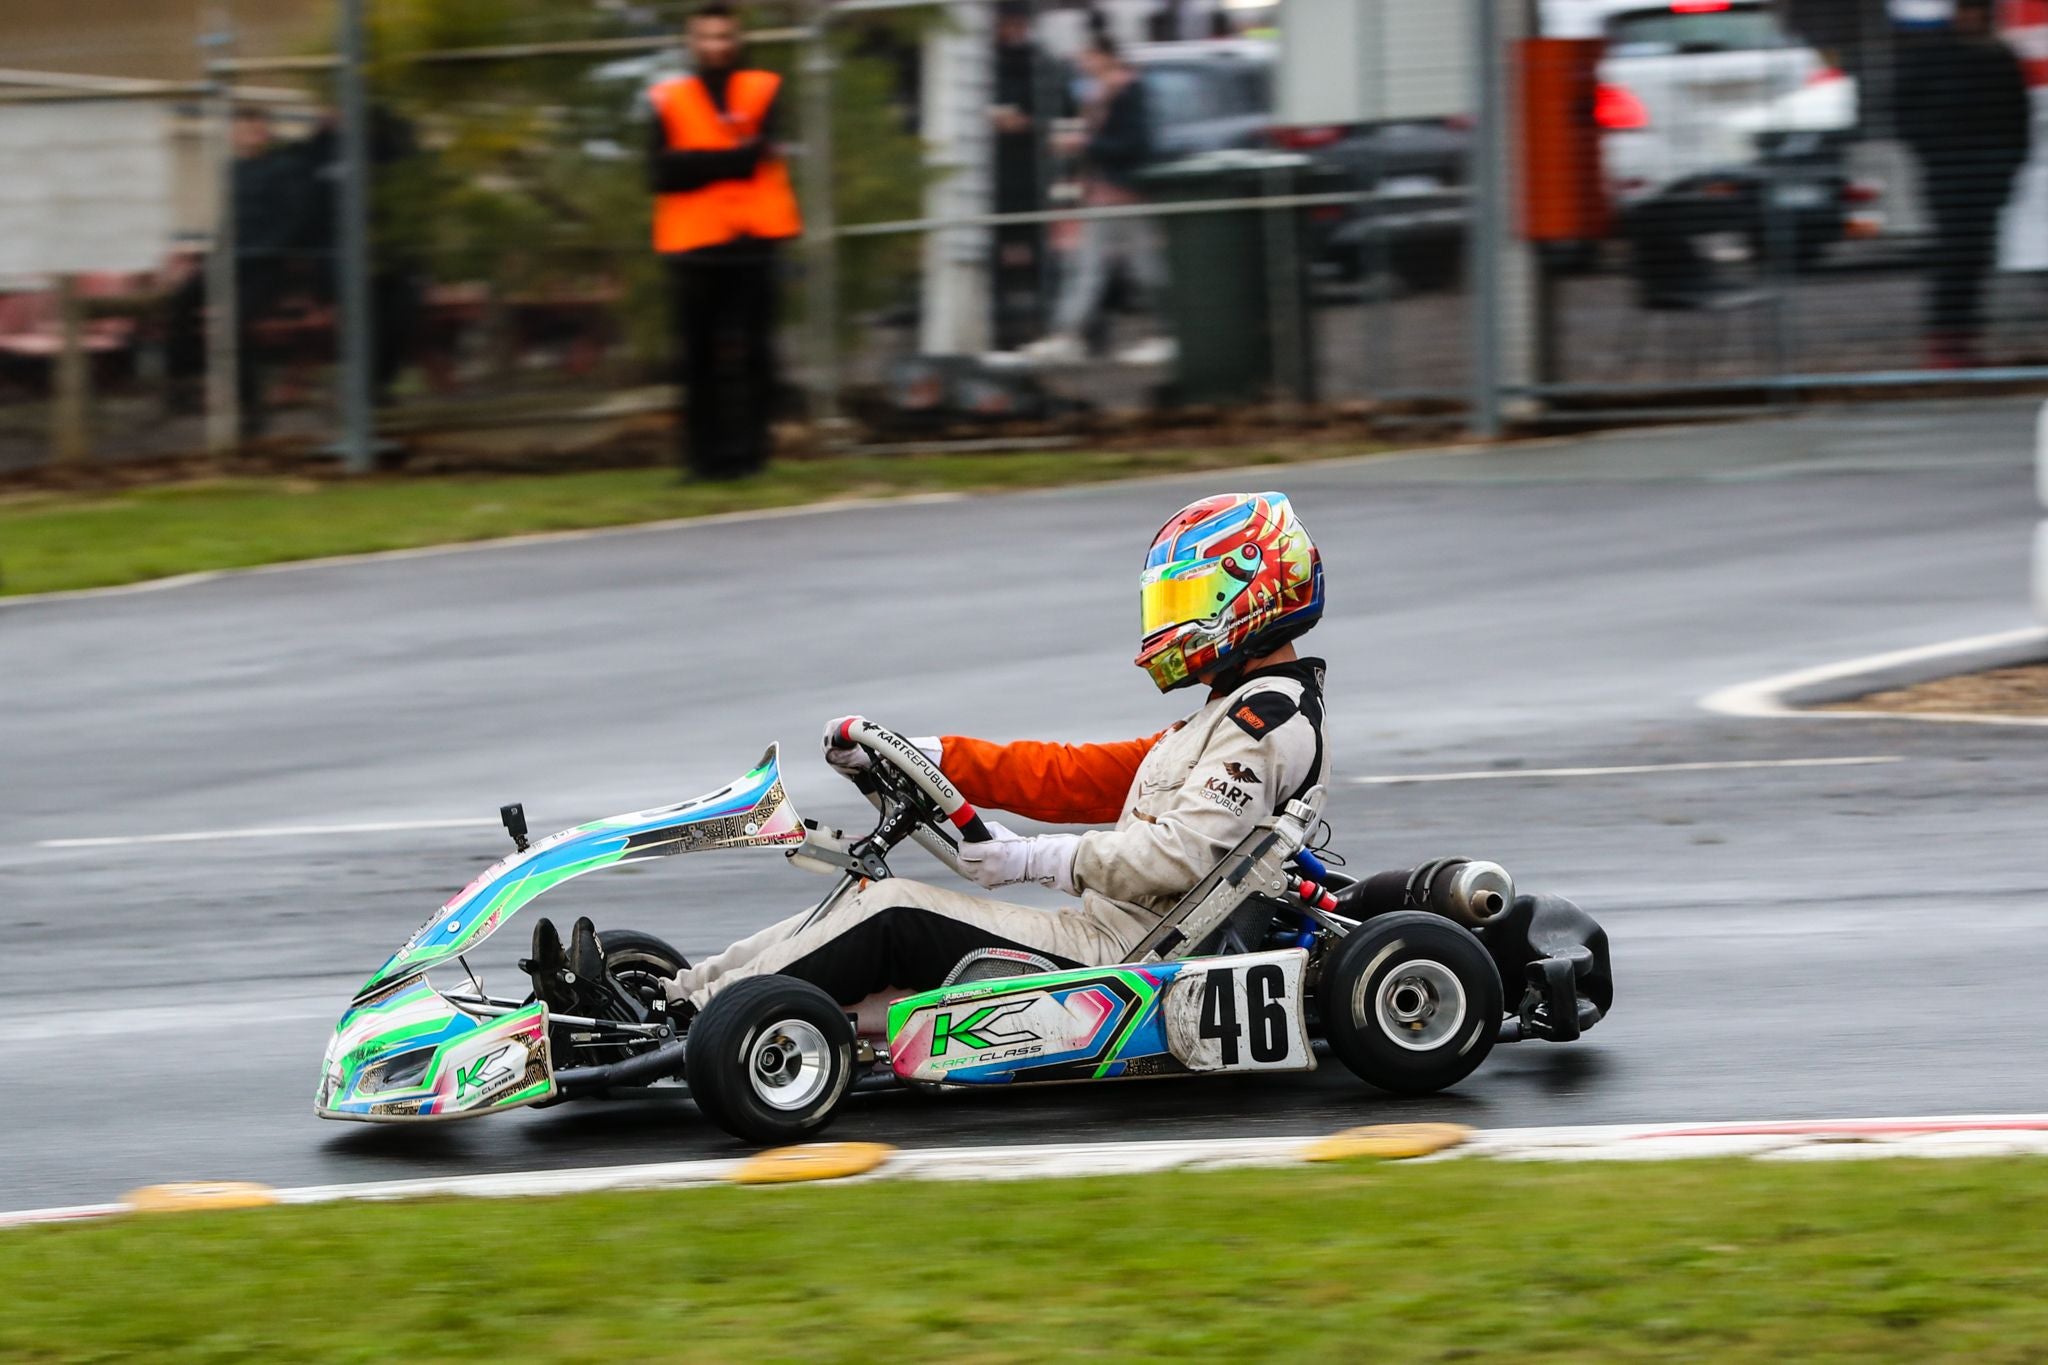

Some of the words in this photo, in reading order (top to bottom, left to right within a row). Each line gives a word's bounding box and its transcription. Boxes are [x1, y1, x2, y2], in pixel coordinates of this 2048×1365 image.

[1200, 788, 1243, 817] REPUBLIC
[1204, 776, 1253, 808] KART
[1199, 964, 1289, 1063] 46
